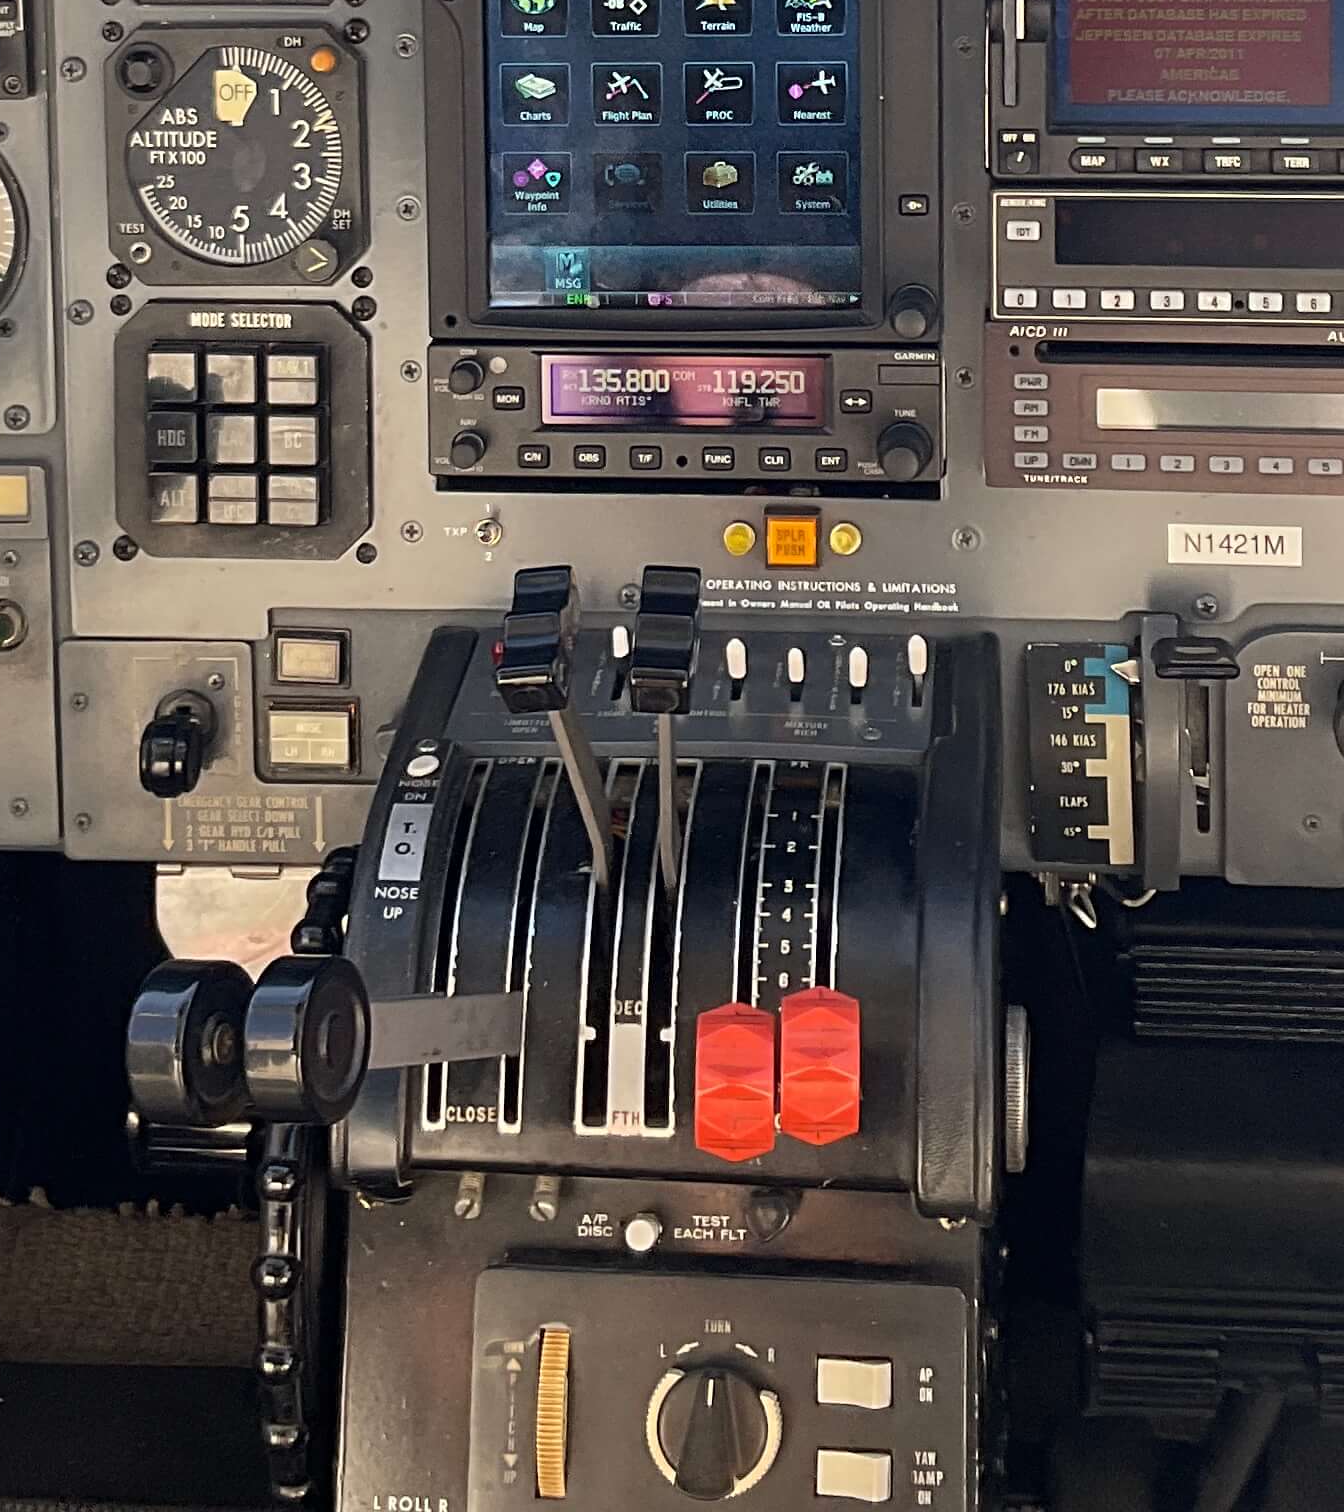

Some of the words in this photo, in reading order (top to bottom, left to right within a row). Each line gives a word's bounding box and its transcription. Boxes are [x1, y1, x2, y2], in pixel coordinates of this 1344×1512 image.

[610, 20, 642, 32] Traffic
[701, 20, 735, 32] Terrain
[790, 22, 832, 33] Weather
[284, 37, 301, 47] DH
[220, 84, 253, 100] OFF
[160, 109, 198, 125] ABS
[520, 111, 551, 121] Charts
[130, 131, 216, 148] ALTITUDE
[191, 313, 225, 327] MODE
[231, 313, 292, 329] SELECTOR
[1010, 325, 1047, 338] AICD
[1053, 327, 1068, 338] III
[578, 369, 670, 393] 135.800
[713, 370, 805, 394] 119.250
[894, 409, 916, 417] TUNE
[1184, 534, 1285, 555] N1421M
[707, 580, 772, 591] OPERATING
[778, 581, 861, 592] INSTRUCTIONS
[868, 581, 877, 592] &
[882, 581, 956, 593] LIMITATIONS
[1048, 683, 1066, 695] 176
[1072, 683, 1095, 695] KIAS
[1050, 735, 1068, 746] 146
[1074, 734, 1096, 747] KIAS
[1060, 797, 1088, 807] FLAPS
[374, 887, 419, 900] NOSE
[383, 906, 403, 919] UP
[446, 1108, 497, 1122] CLOSE
[692, 1215, 730, 1227] TEST
[674, 1228, 714, 1240] EACH
[719, 1228, 746, 1241] FLT
